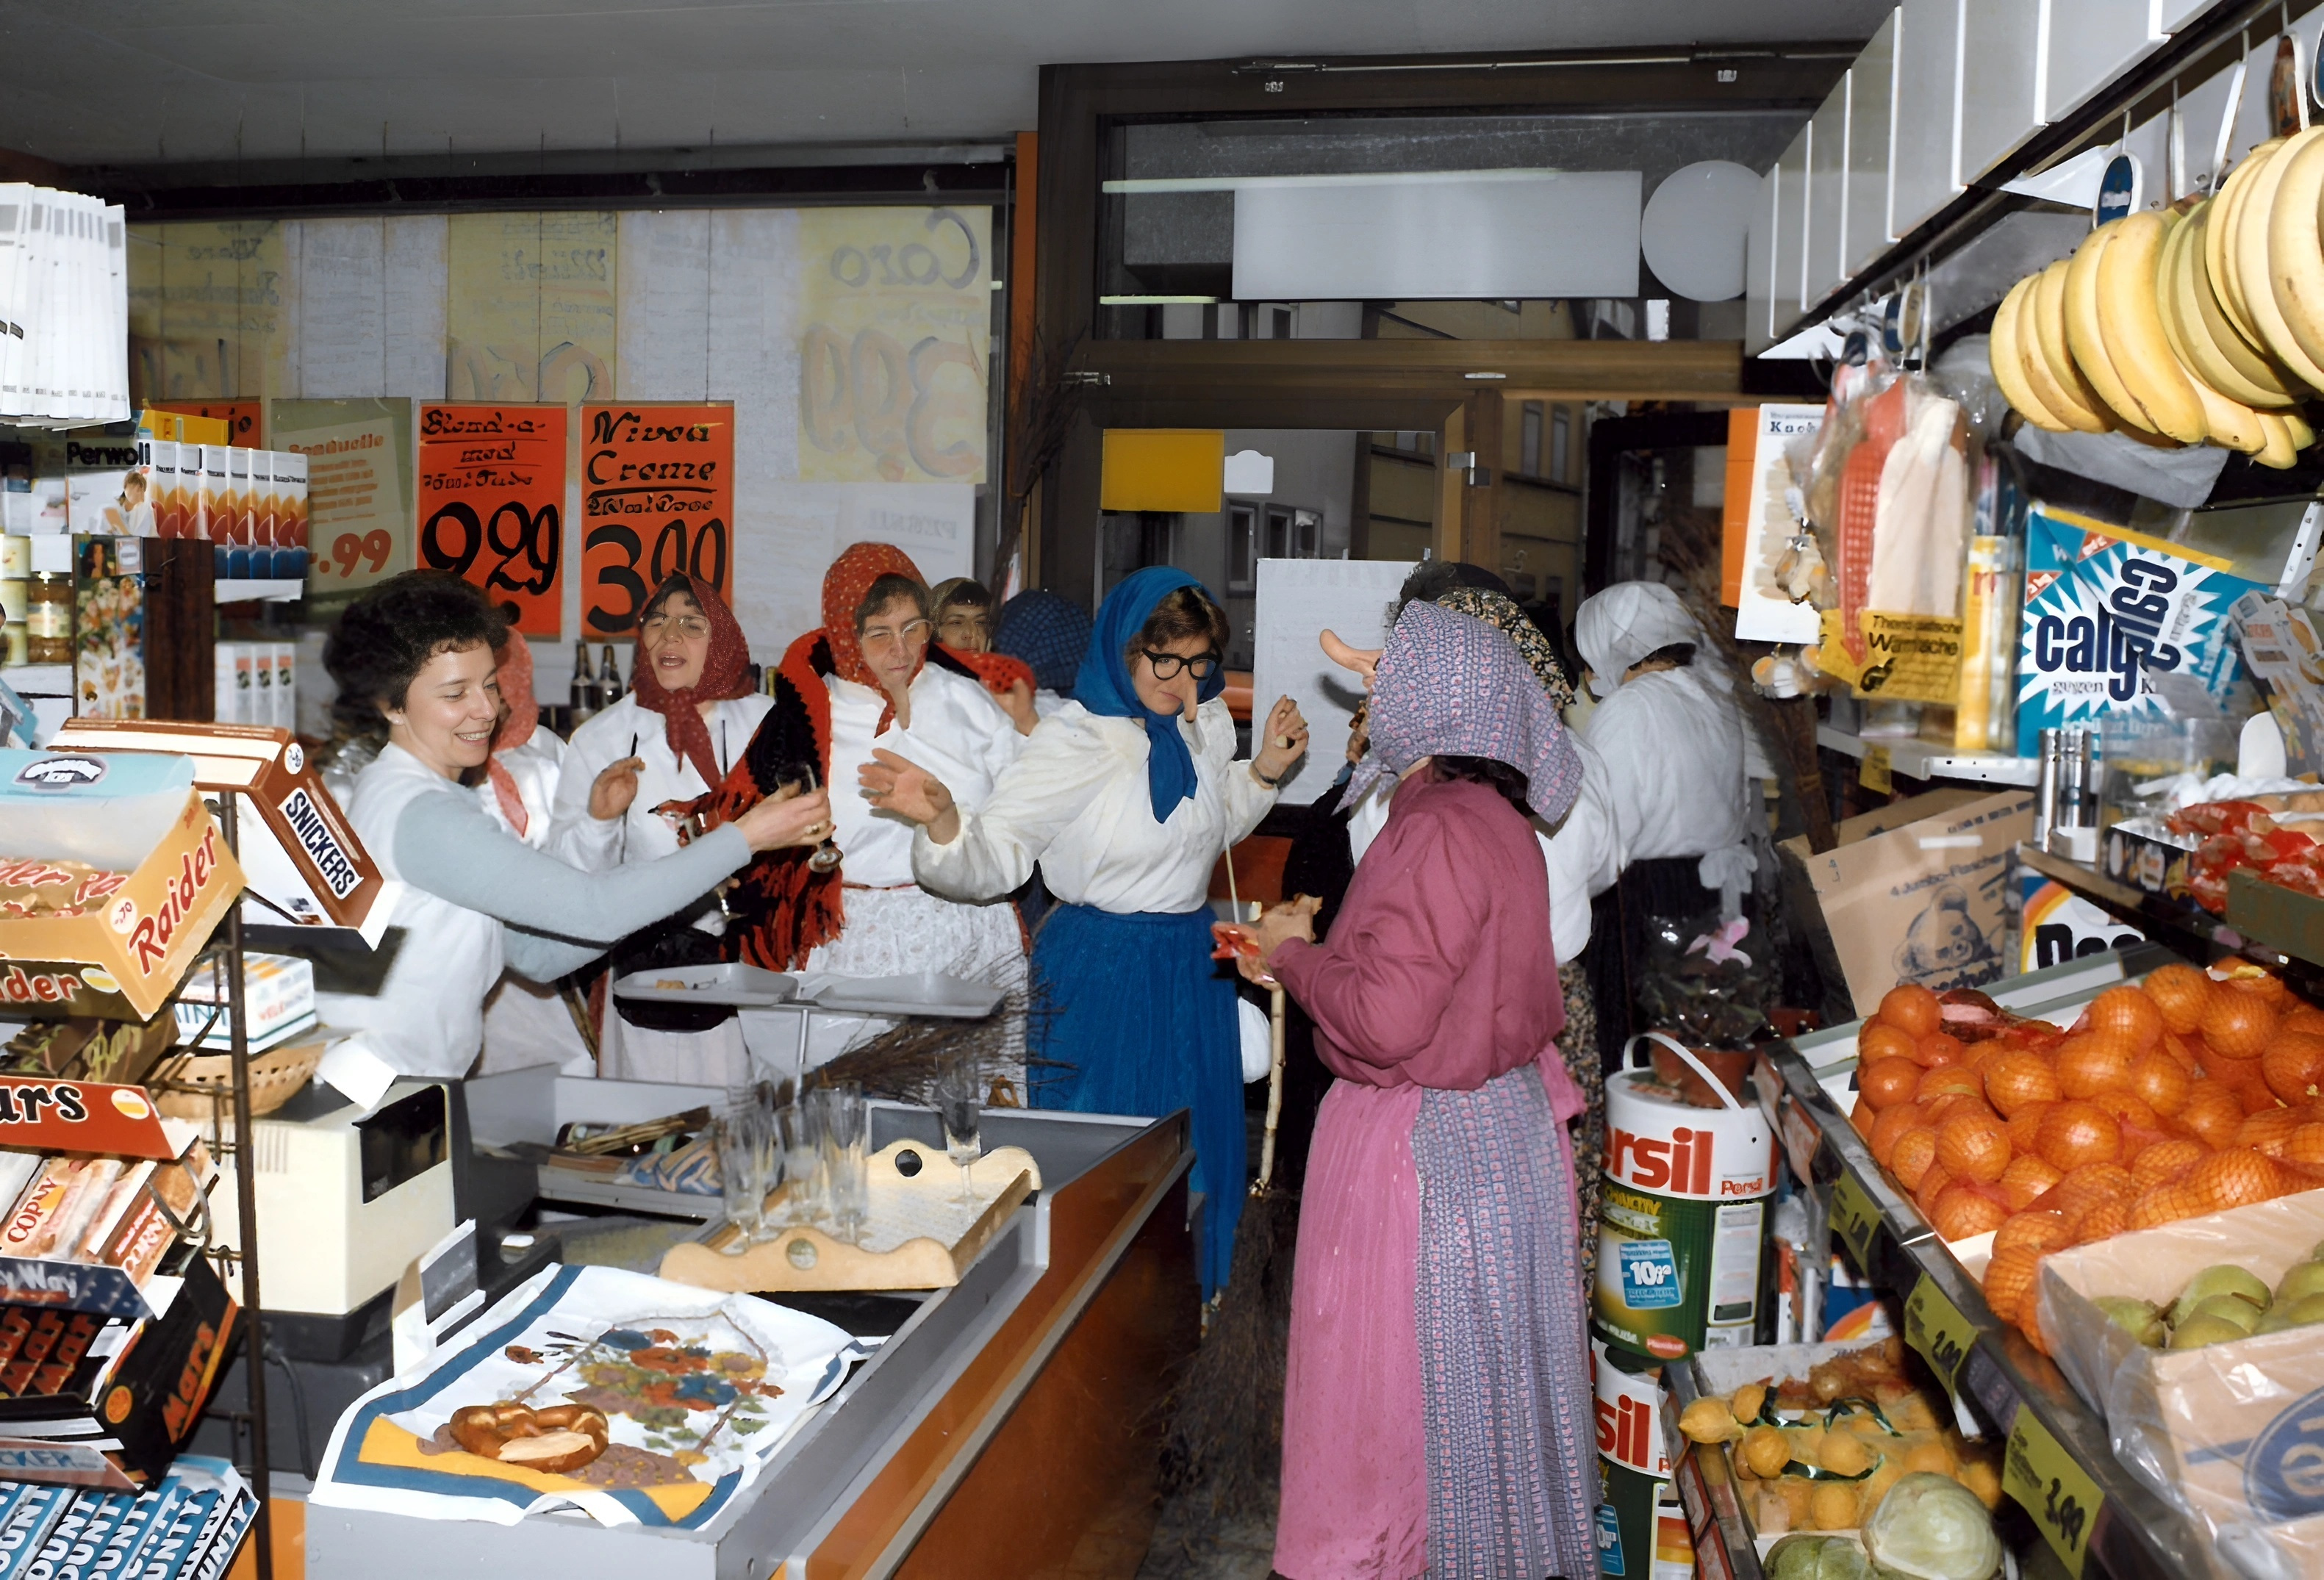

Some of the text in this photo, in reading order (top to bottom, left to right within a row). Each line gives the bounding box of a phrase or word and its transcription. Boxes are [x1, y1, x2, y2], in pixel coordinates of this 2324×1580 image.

[589, 410, 709, 444] Nivea
[66, 441, 151, 466] Perwoll
[587, 450, 716, 485] Creme
[286, 791, 355, 895] SNICKERS
[129, 825, 215, 975] Raider
